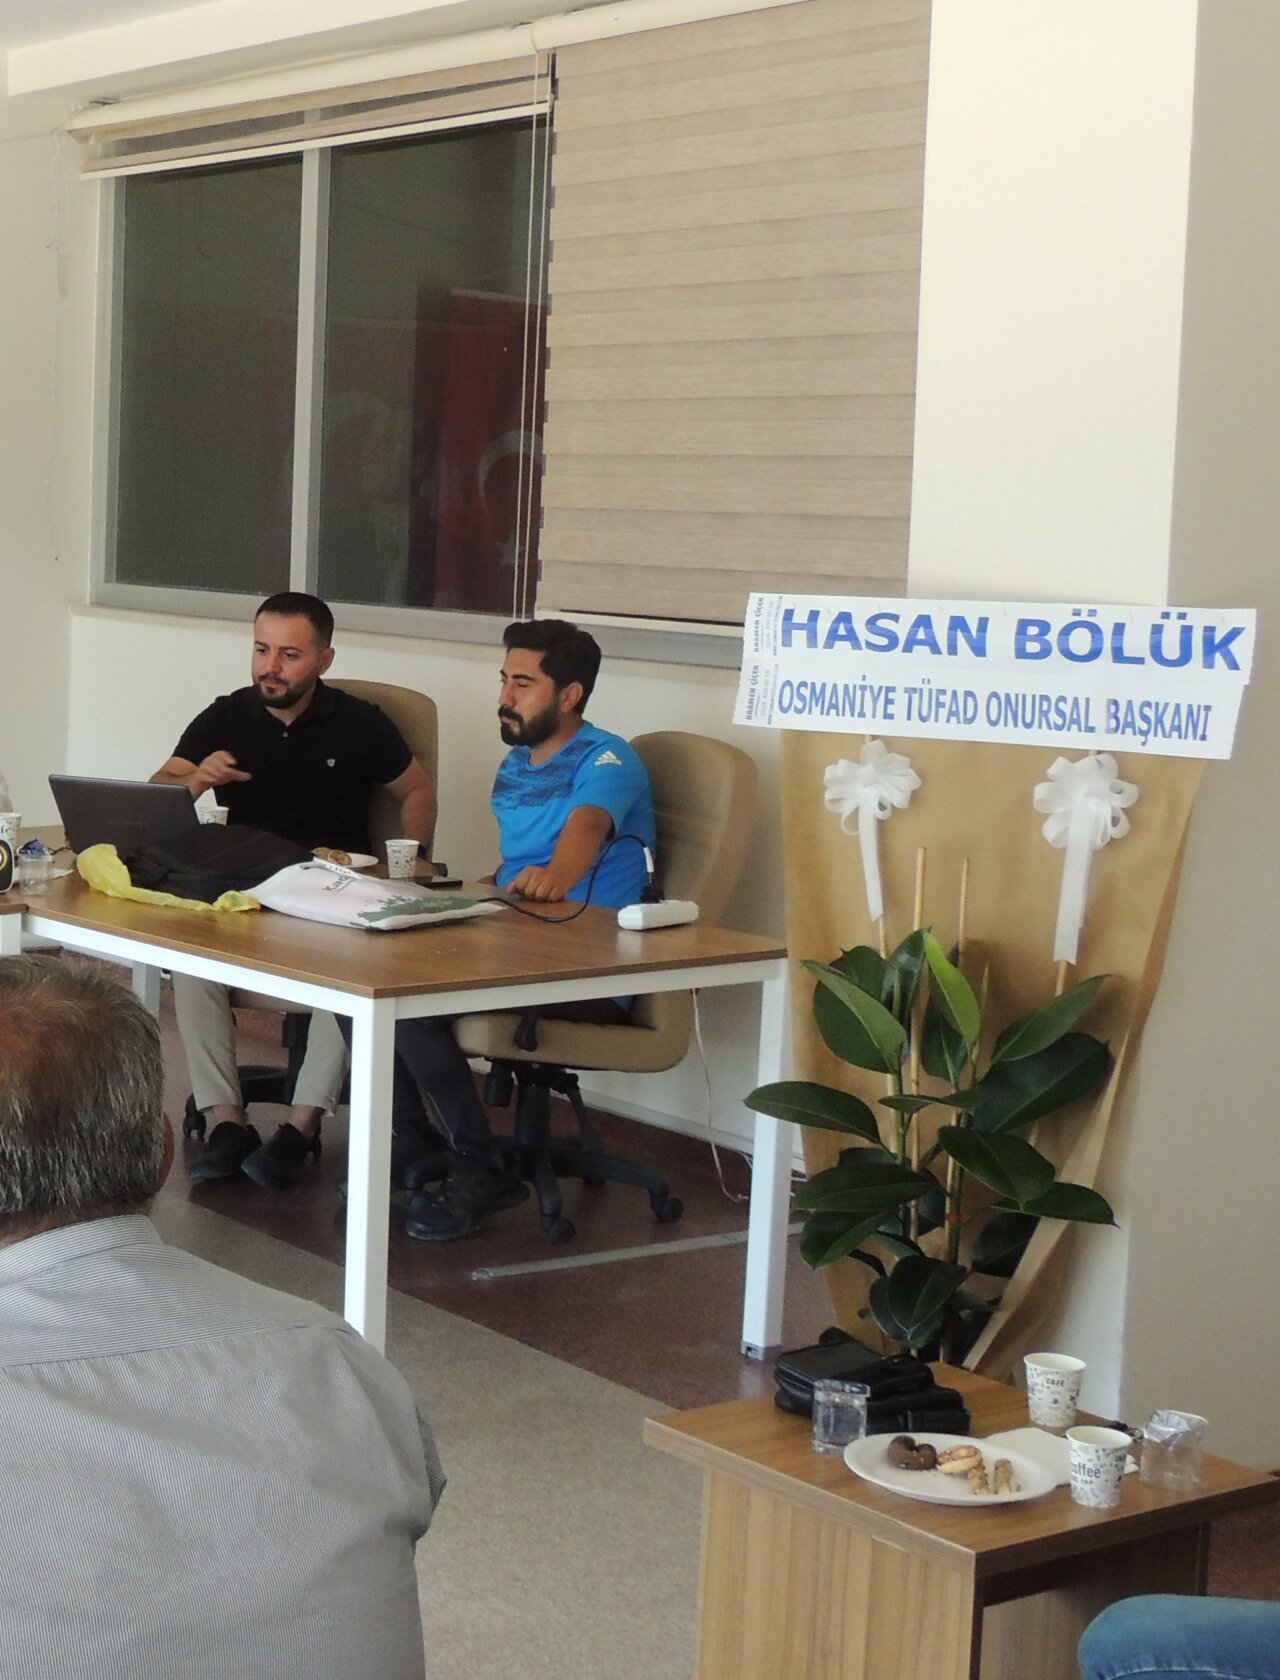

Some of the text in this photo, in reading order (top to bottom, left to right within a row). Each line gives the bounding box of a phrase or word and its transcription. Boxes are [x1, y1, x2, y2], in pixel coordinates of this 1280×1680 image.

[781, 608, 990, 658] HASAN
[1014, 608, 1247, 671] BÖLÜK
[778, 674, 897, 721] OSMANİYE
[903, 677, 978, 726] TÜFAD
[985, 690, 1096, 734] ONURSAL
[1105, 697, 1213, 747] BAŞKANI
